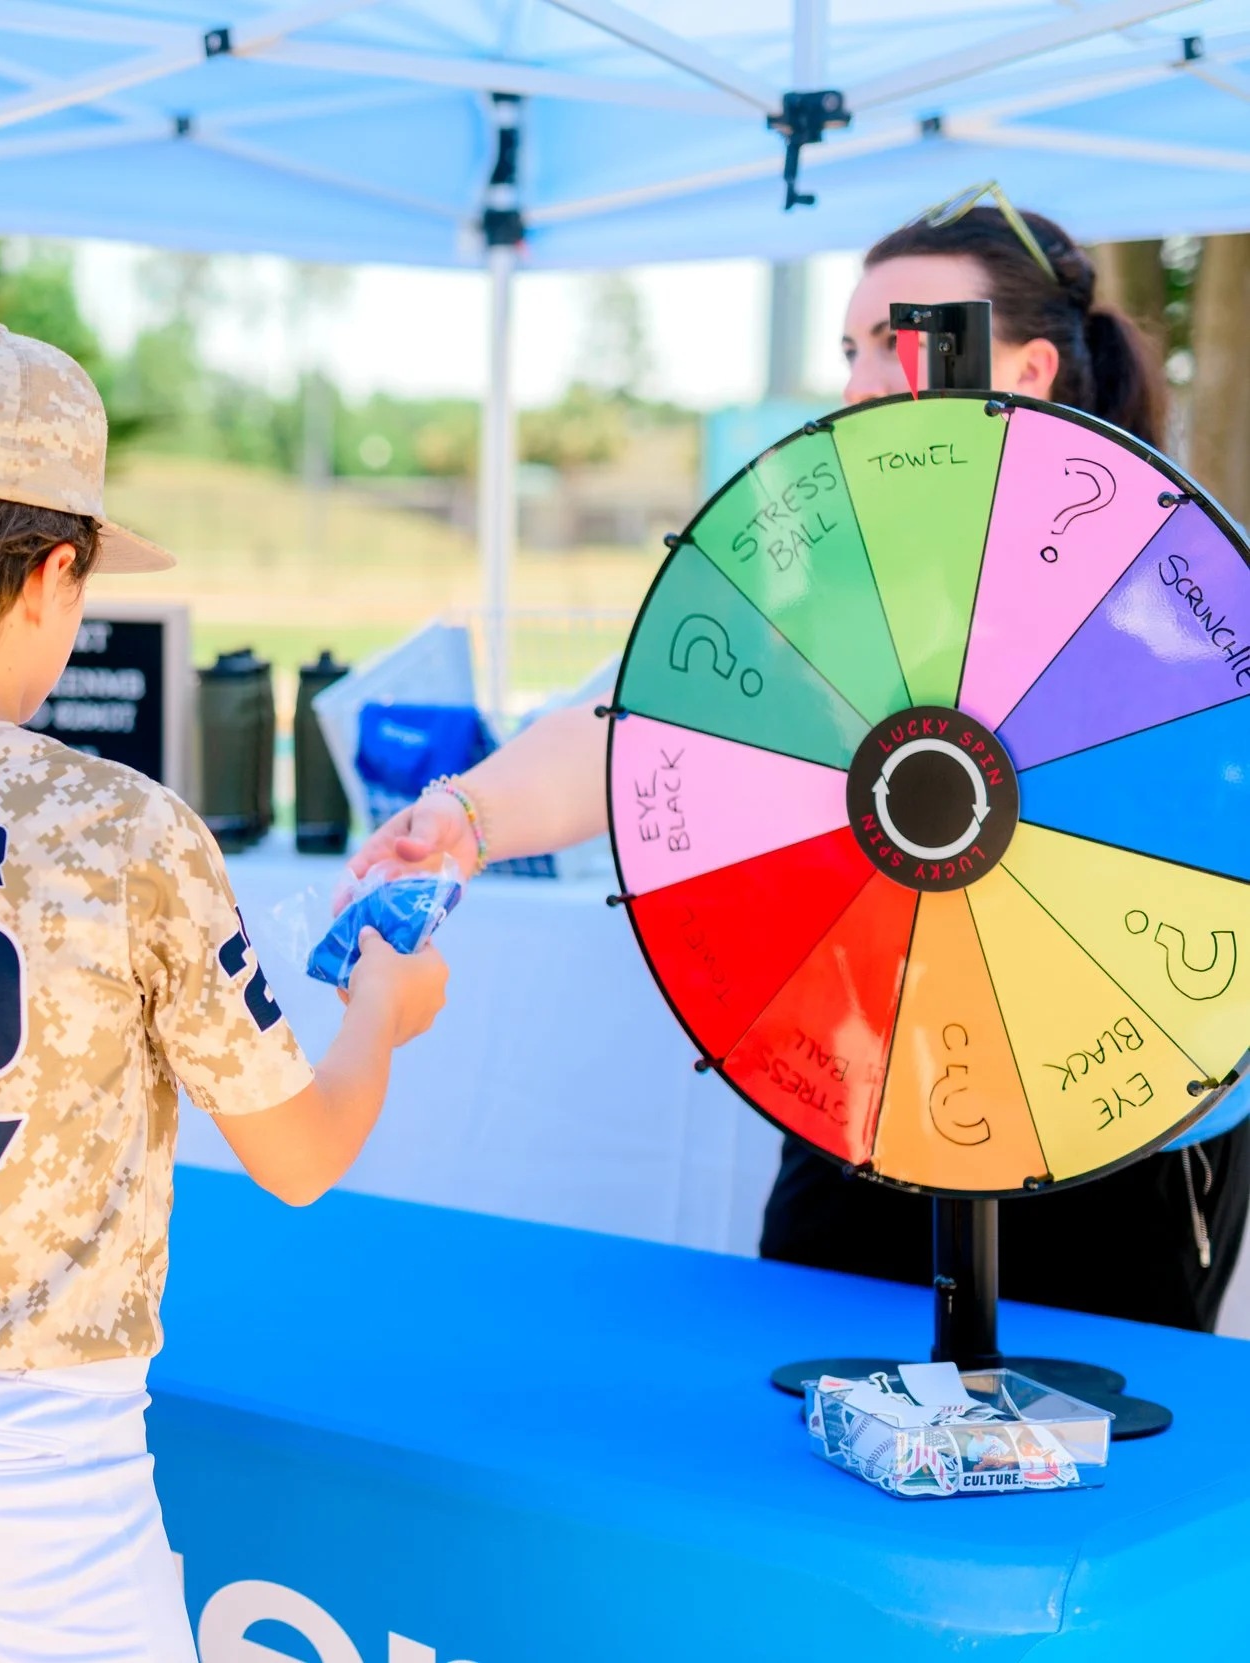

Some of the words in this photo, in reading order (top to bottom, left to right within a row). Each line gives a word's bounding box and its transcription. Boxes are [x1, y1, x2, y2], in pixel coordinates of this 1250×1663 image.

[867, 443, 969, 473] TOWEL
[731, 461, 838, 564] STRESS
[766, 512, 838, 573] BALL
[877, 718, 950, 753] LUCKY
[958, 730, 1004, 787] SPIN
[634, 768, 661, 843] EYE
[659, 747, 692, 853] BLACK
[860, 813, 905, 868] SPIN
[914, 845, 987, 881] LUCKY
[679, 904, 731, 1010] TOWEL
[794, 1027, 851, 1083] BALL
[1041, 1016, 1145, 1092] BLACK
[1091, 1071, 1154, 1132] EYE
[962, 1472, 1024, 1488] CULTURE.
